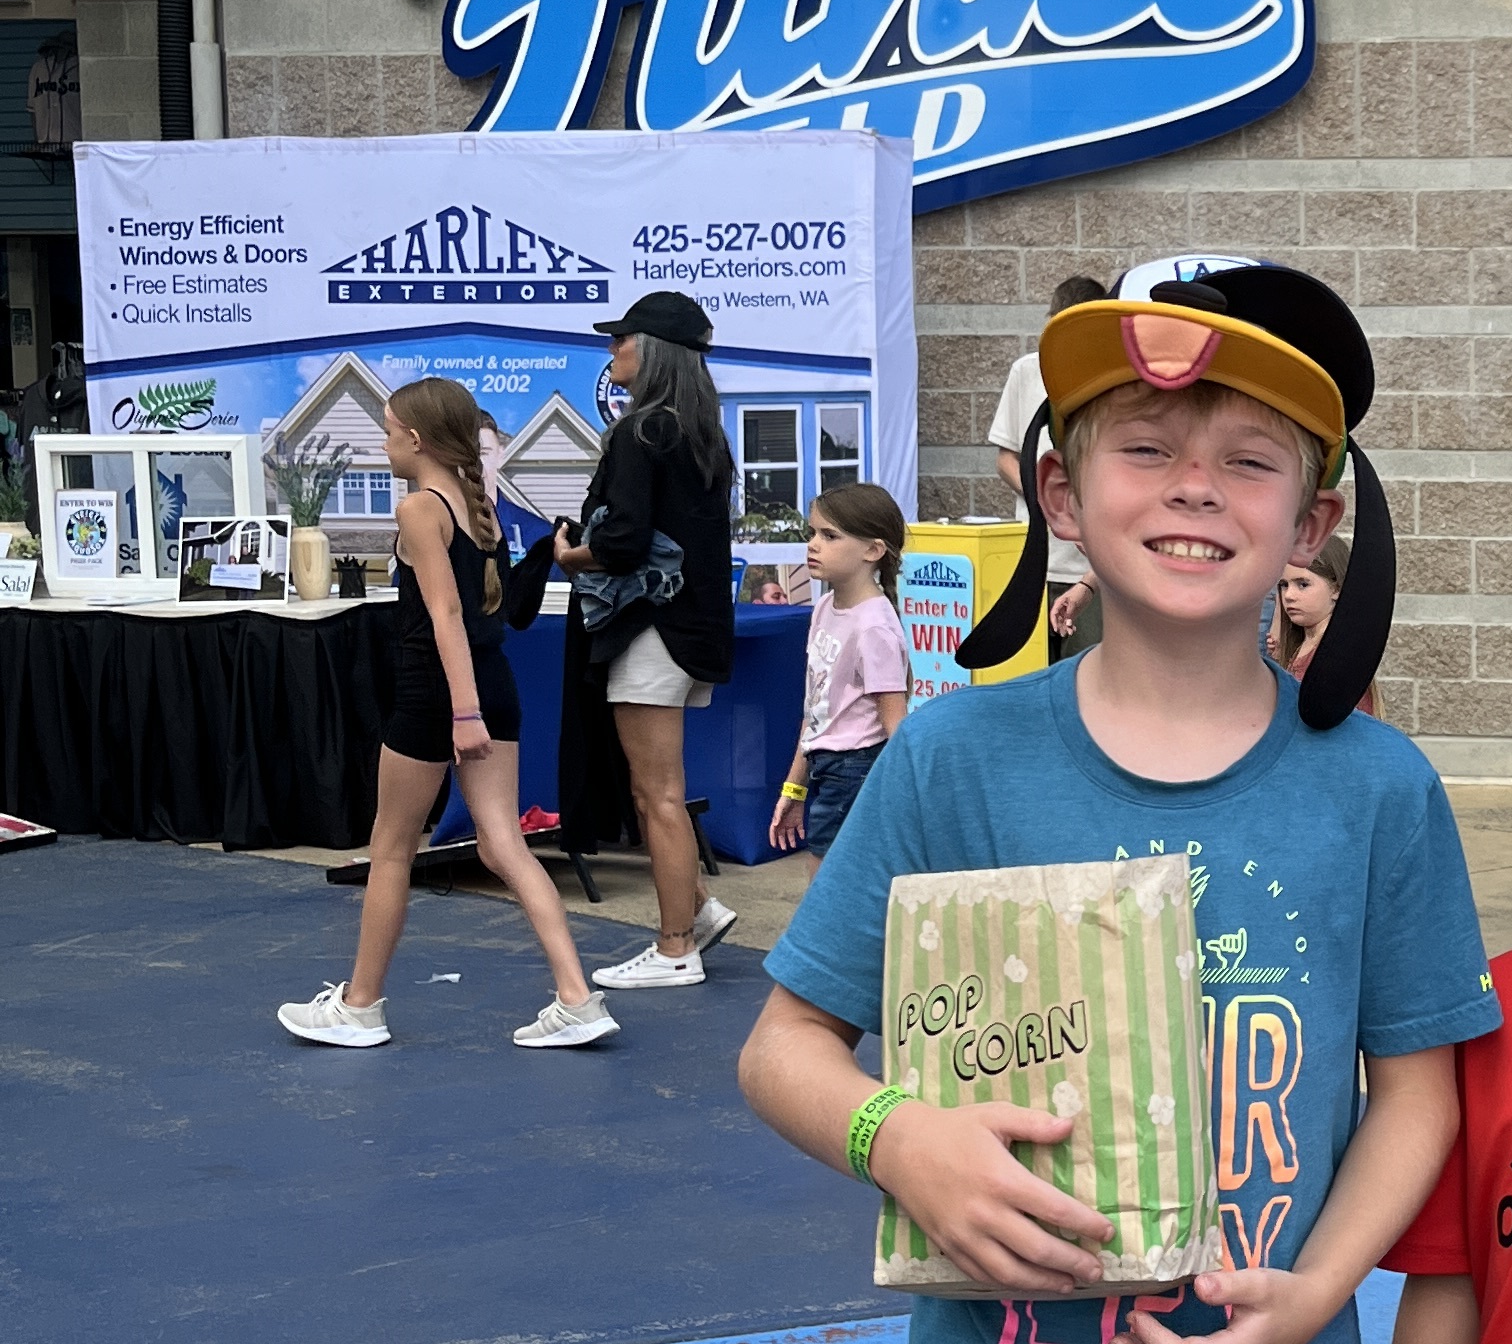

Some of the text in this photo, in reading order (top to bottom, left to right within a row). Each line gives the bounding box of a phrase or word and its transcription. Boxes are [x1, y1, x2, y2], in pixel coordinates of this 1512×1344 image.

[119, 214, 285, 240] Energy Efficient
[361, 204, 574, 274] HARLEY
[632, 221, 846, 253] 425-527-0076
[119, 243, 308, 266] Windows & Doors
[633, 257, 846, 284] HarleyExteriors.com
[123, 274, 268, 294] Free Estimates
[338, 284, 600, 301] EXTERIORS
[723, 292, 796, 310] Western,
[800, 290, 830, 306] WA
[122, 302, 252, 324] Quick Installs
[382, 354, 568, 373] Family owned & operated
[481, 374, 532, 394] 2002
[178, 397, 240, 431] Series
[913, 561, 962, 582] HARLEY
[903, 596, 969, 620] Enter to
[911, 623, 962, 654] WIN
[1114, 839, 1310, 984] AND ENJOY
[898, 974, 984, 1047] POP
[953, 999, 1089, 1082] CORN
